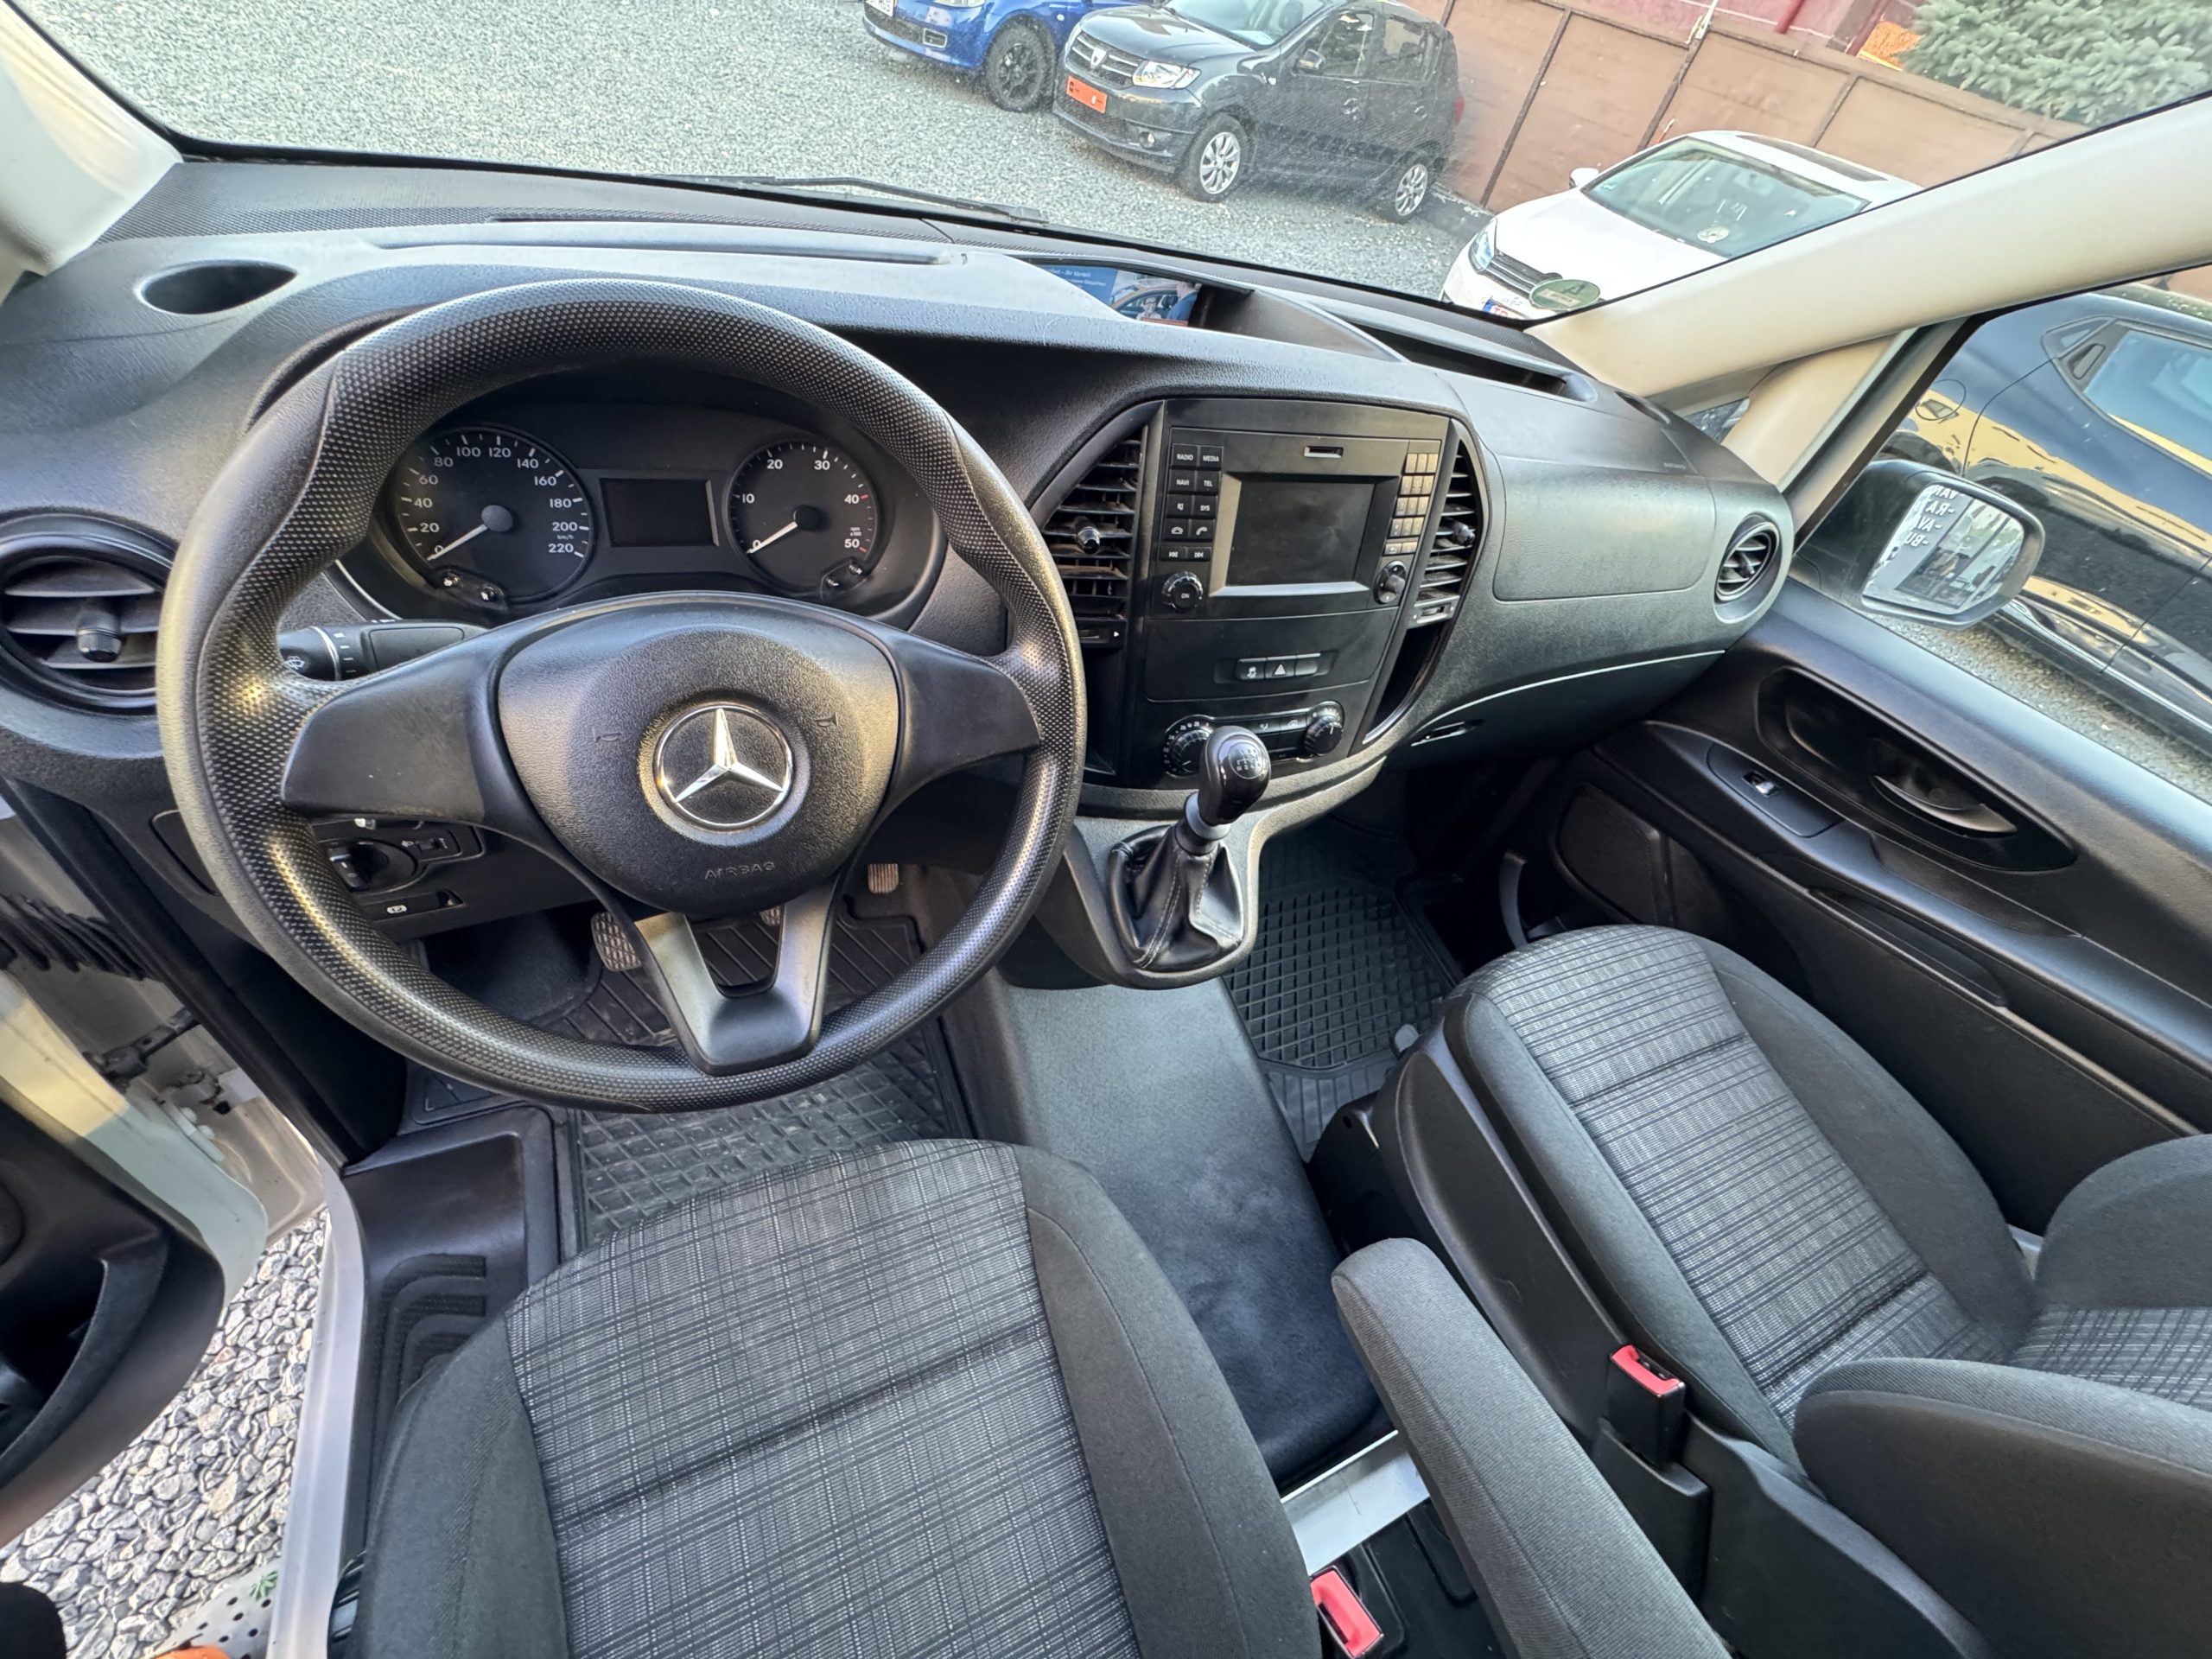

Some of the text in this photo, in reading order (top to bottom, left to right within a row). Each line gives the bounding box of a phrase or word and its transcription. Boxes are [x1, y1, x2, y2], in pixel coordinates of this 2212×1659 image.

[456, 447, 481, 457] 100
[488, 448, 512, 458] 120
[434, 457, 454, 467] 80
[517, 459, 539, 469] 140
[766, 459, 784, 469] 20
[814, 460, 830, 470] 30
[419, 474, 439, 485] 60
[534, 476, 556, 486] 160
[414, 498, 433, 508] 40
[550, 498, 572, 508] 180
[741, 493, 755, 504] 10
[844, 494, 860, 505] 40
[420, 522, 440, 533] 20
[552, 521, 578, 531] 200
[548, 543, 574, 554] 220
[844, 538, 861, 549] 50
[704, 861, 776, 880] AIRBAG
